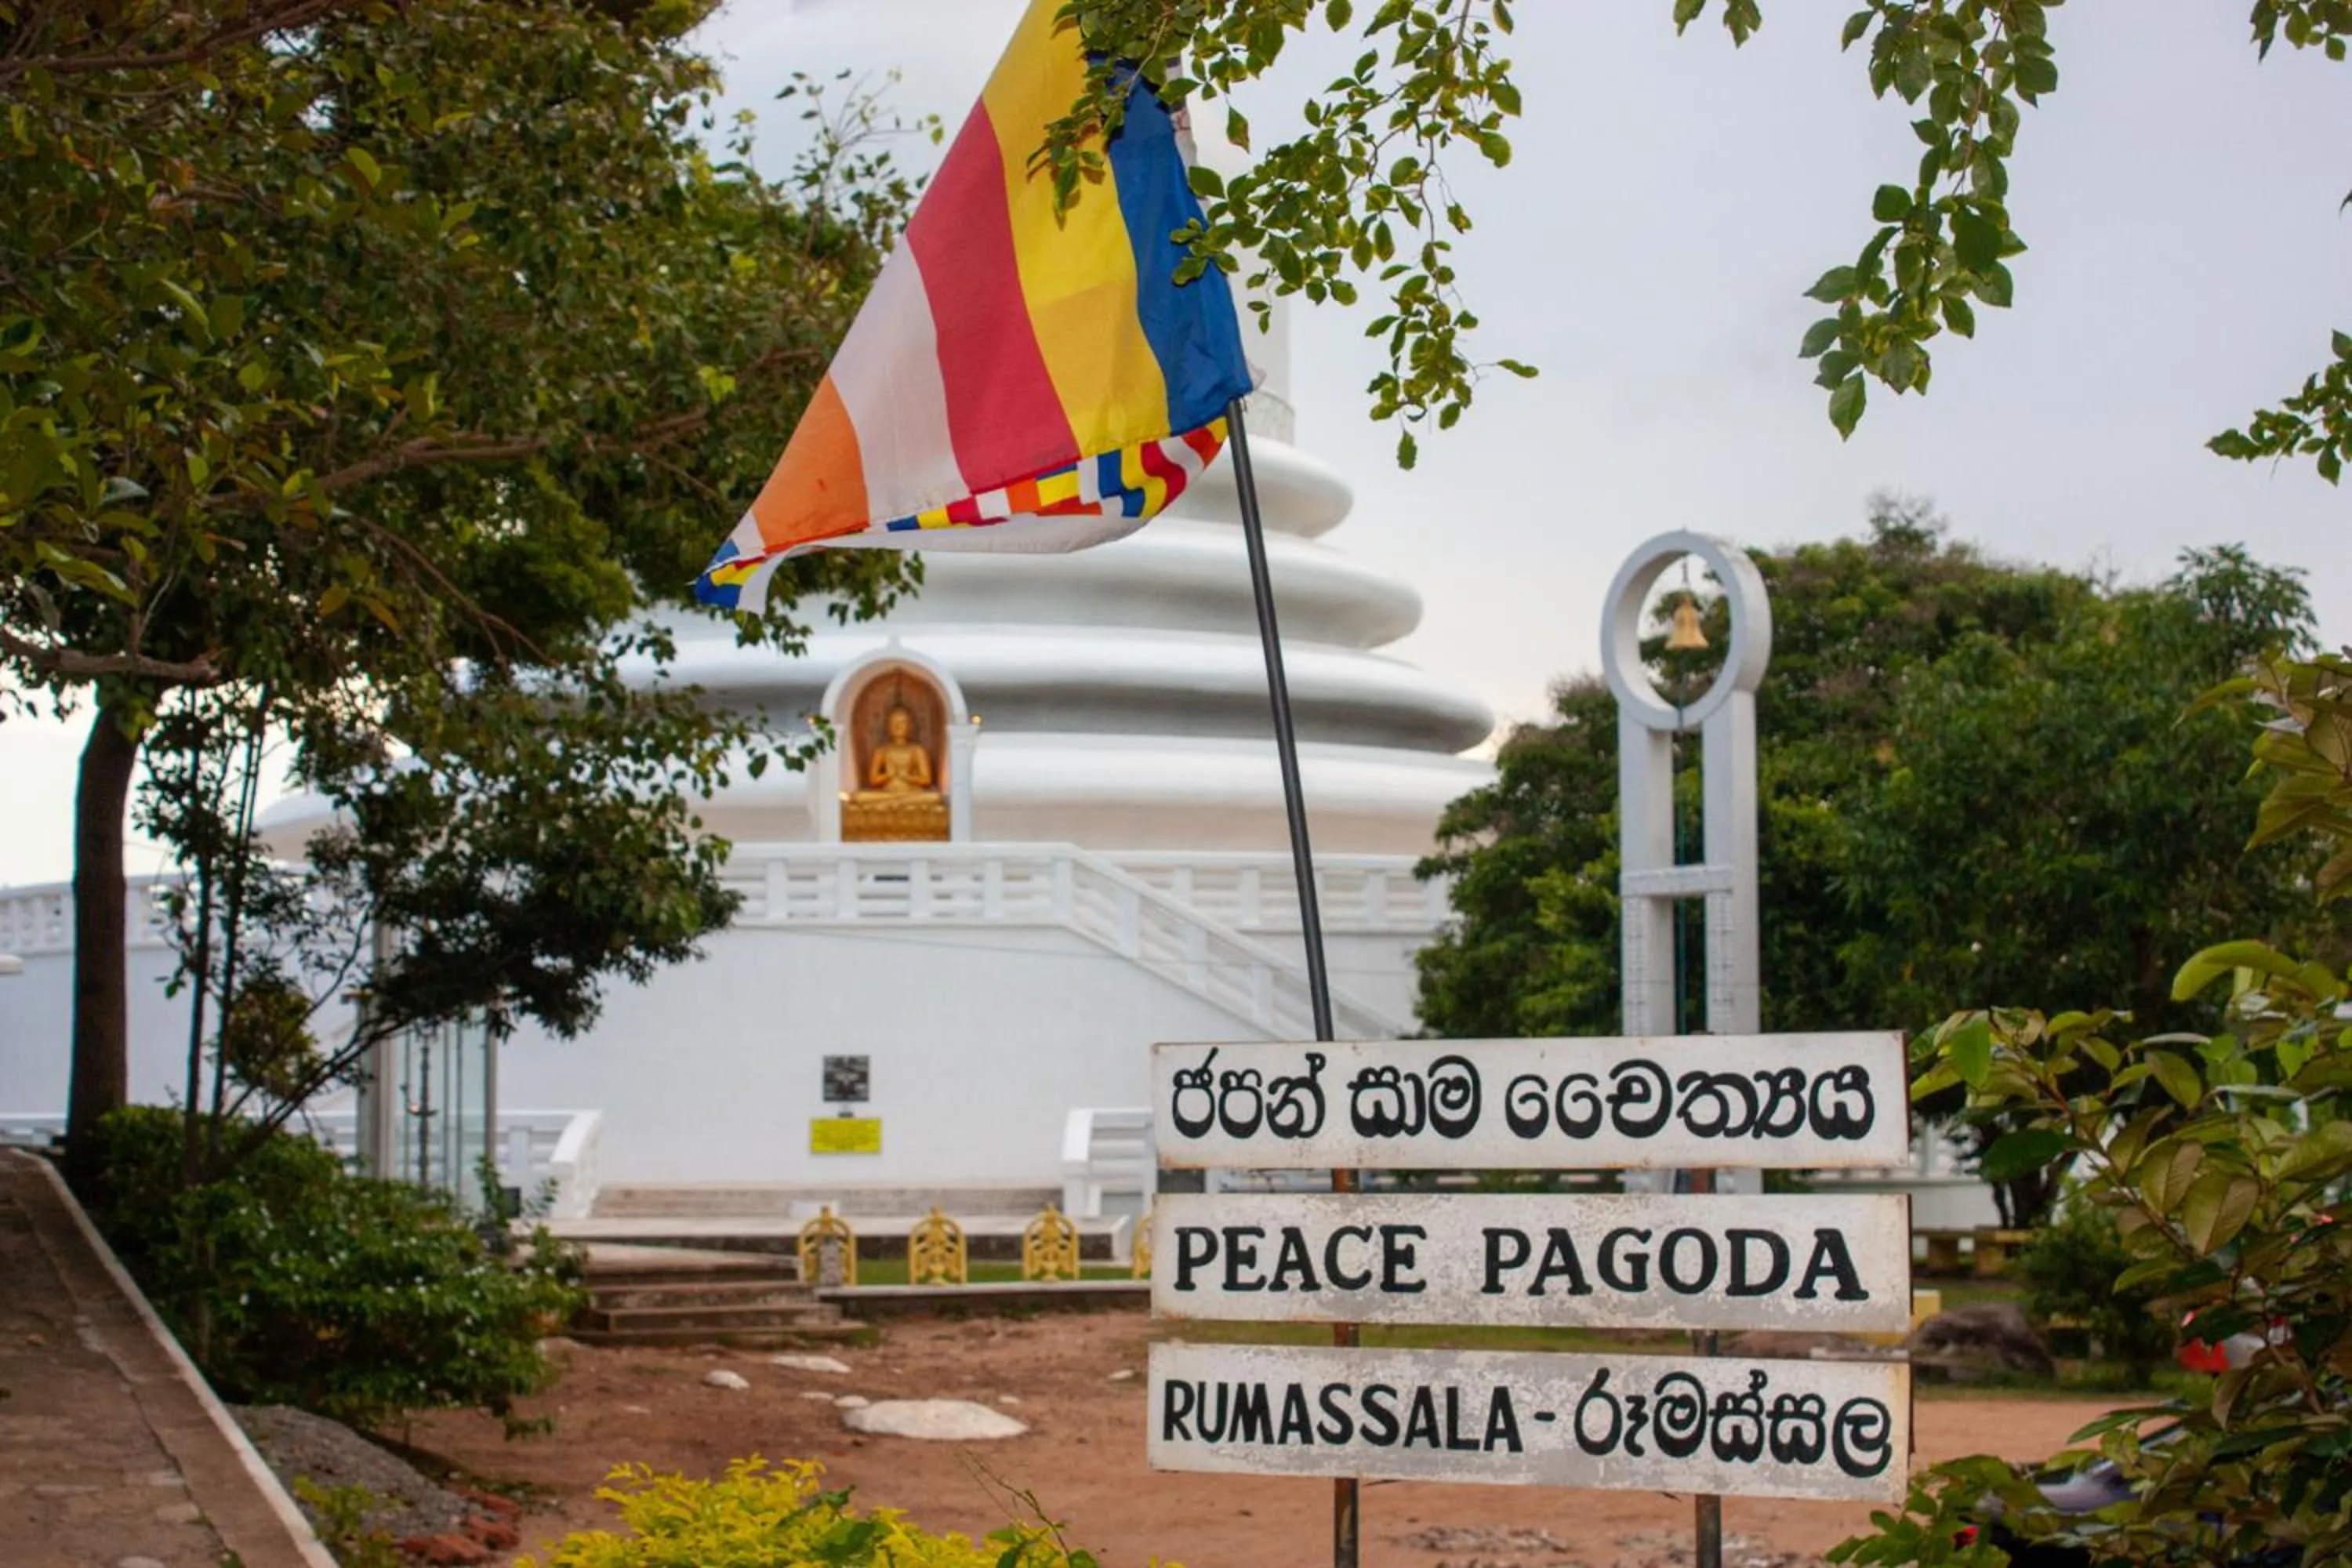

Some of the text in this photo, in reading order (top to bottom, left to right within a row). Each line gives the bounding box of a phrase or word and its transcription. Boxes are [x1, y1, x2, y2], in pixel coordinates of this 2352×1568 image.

[1173, 1047, 1327, 1138] ජපන්
[1347, 1054, 1482, 1138] සාම
[1174, 1225, 1870, 1301] PEACE PAGODA
[1163, 1380, 1523, 1453] RUMASSALA
[1574, 1367, 1892, 1478] රූමස්සල
